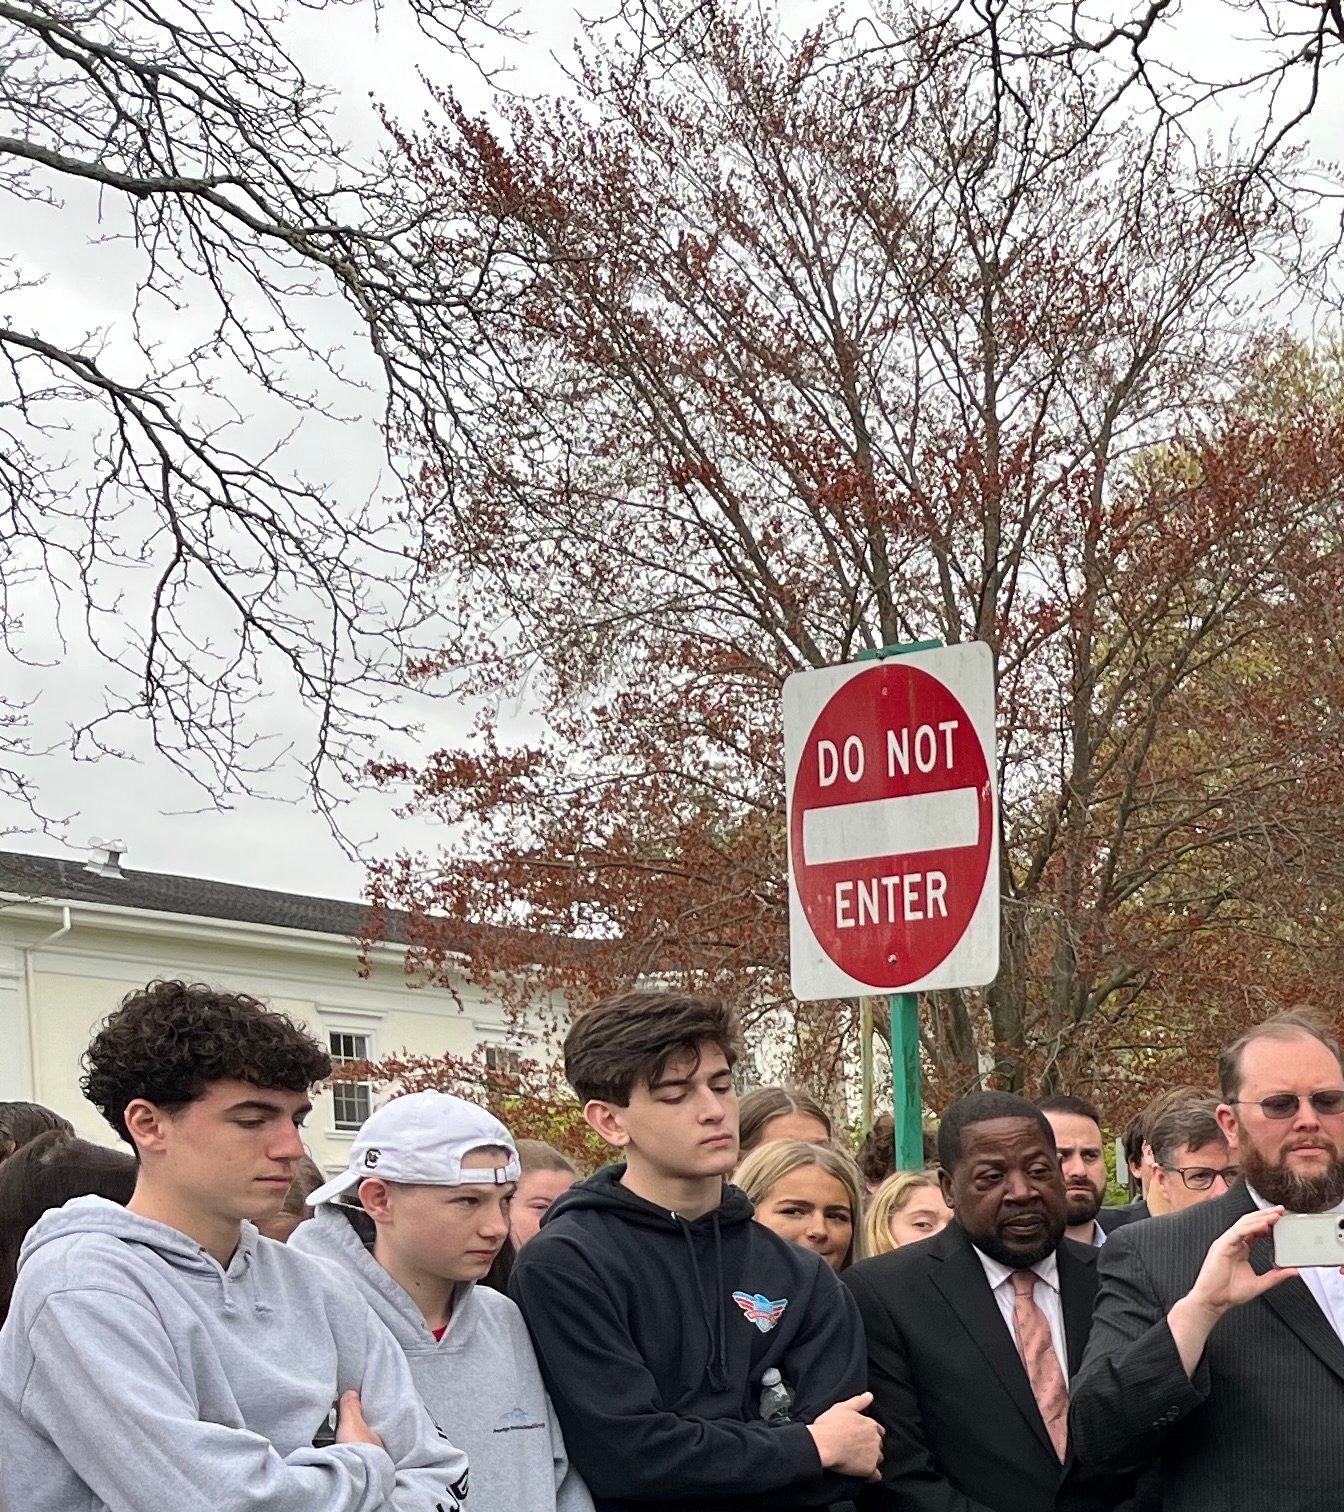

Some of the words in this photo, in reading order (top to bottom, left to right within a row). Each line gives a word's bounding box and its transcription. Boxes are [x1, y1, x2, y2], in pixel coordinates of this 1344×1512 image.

[817, 734, 865, 788] DO
[886, 720, 959, 778] NOT
[835, 870, 949, 929] ENTER
